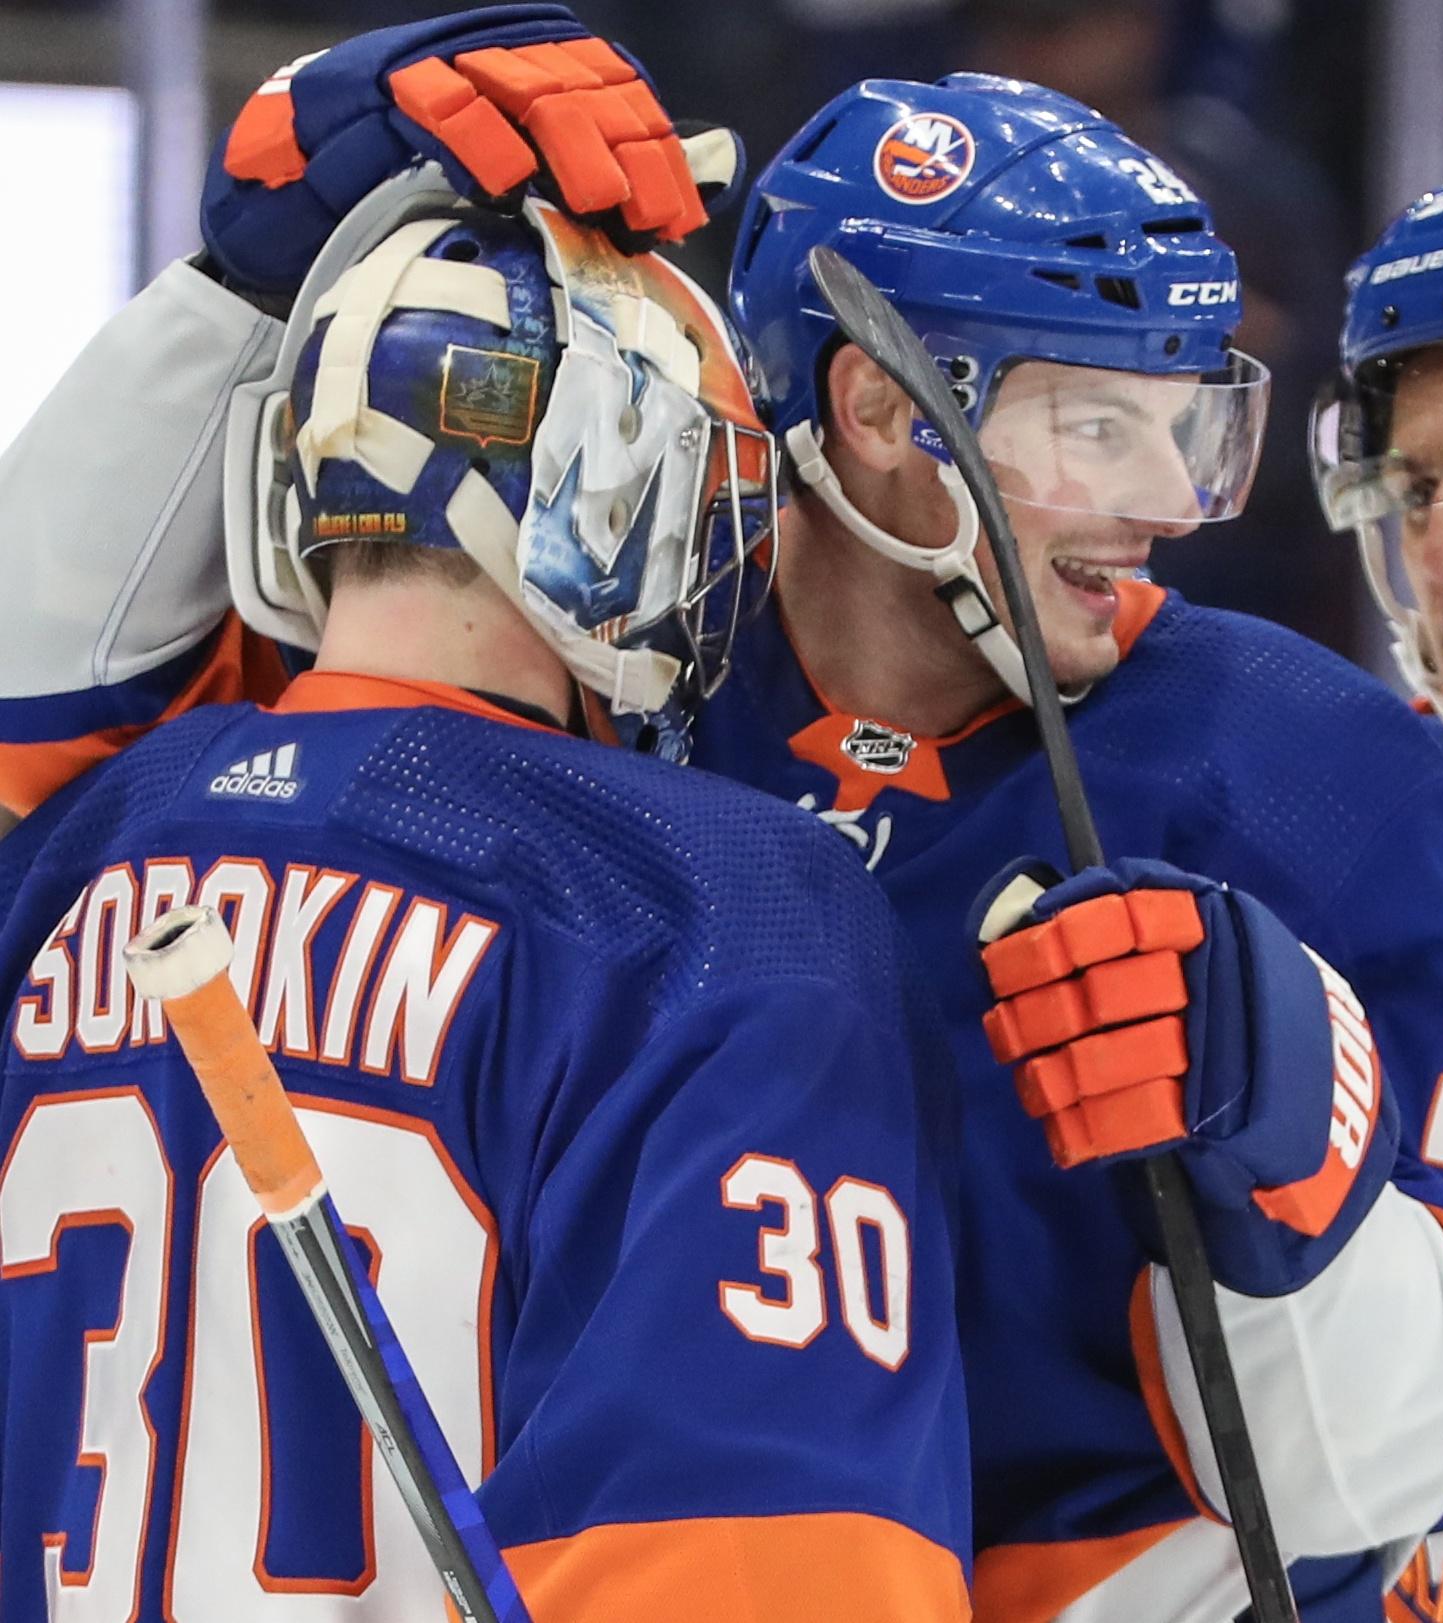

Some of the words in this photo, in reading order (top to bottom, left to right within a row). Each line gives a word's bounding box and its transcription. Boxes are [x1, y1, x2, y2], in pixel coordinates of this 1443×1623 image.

[1167, 279, 1238, 306] CCM
[210, 772, 298, 799] adidas
[719, 1152, 912, 1373] 30
[0, 1085, 499, 1623] 30
